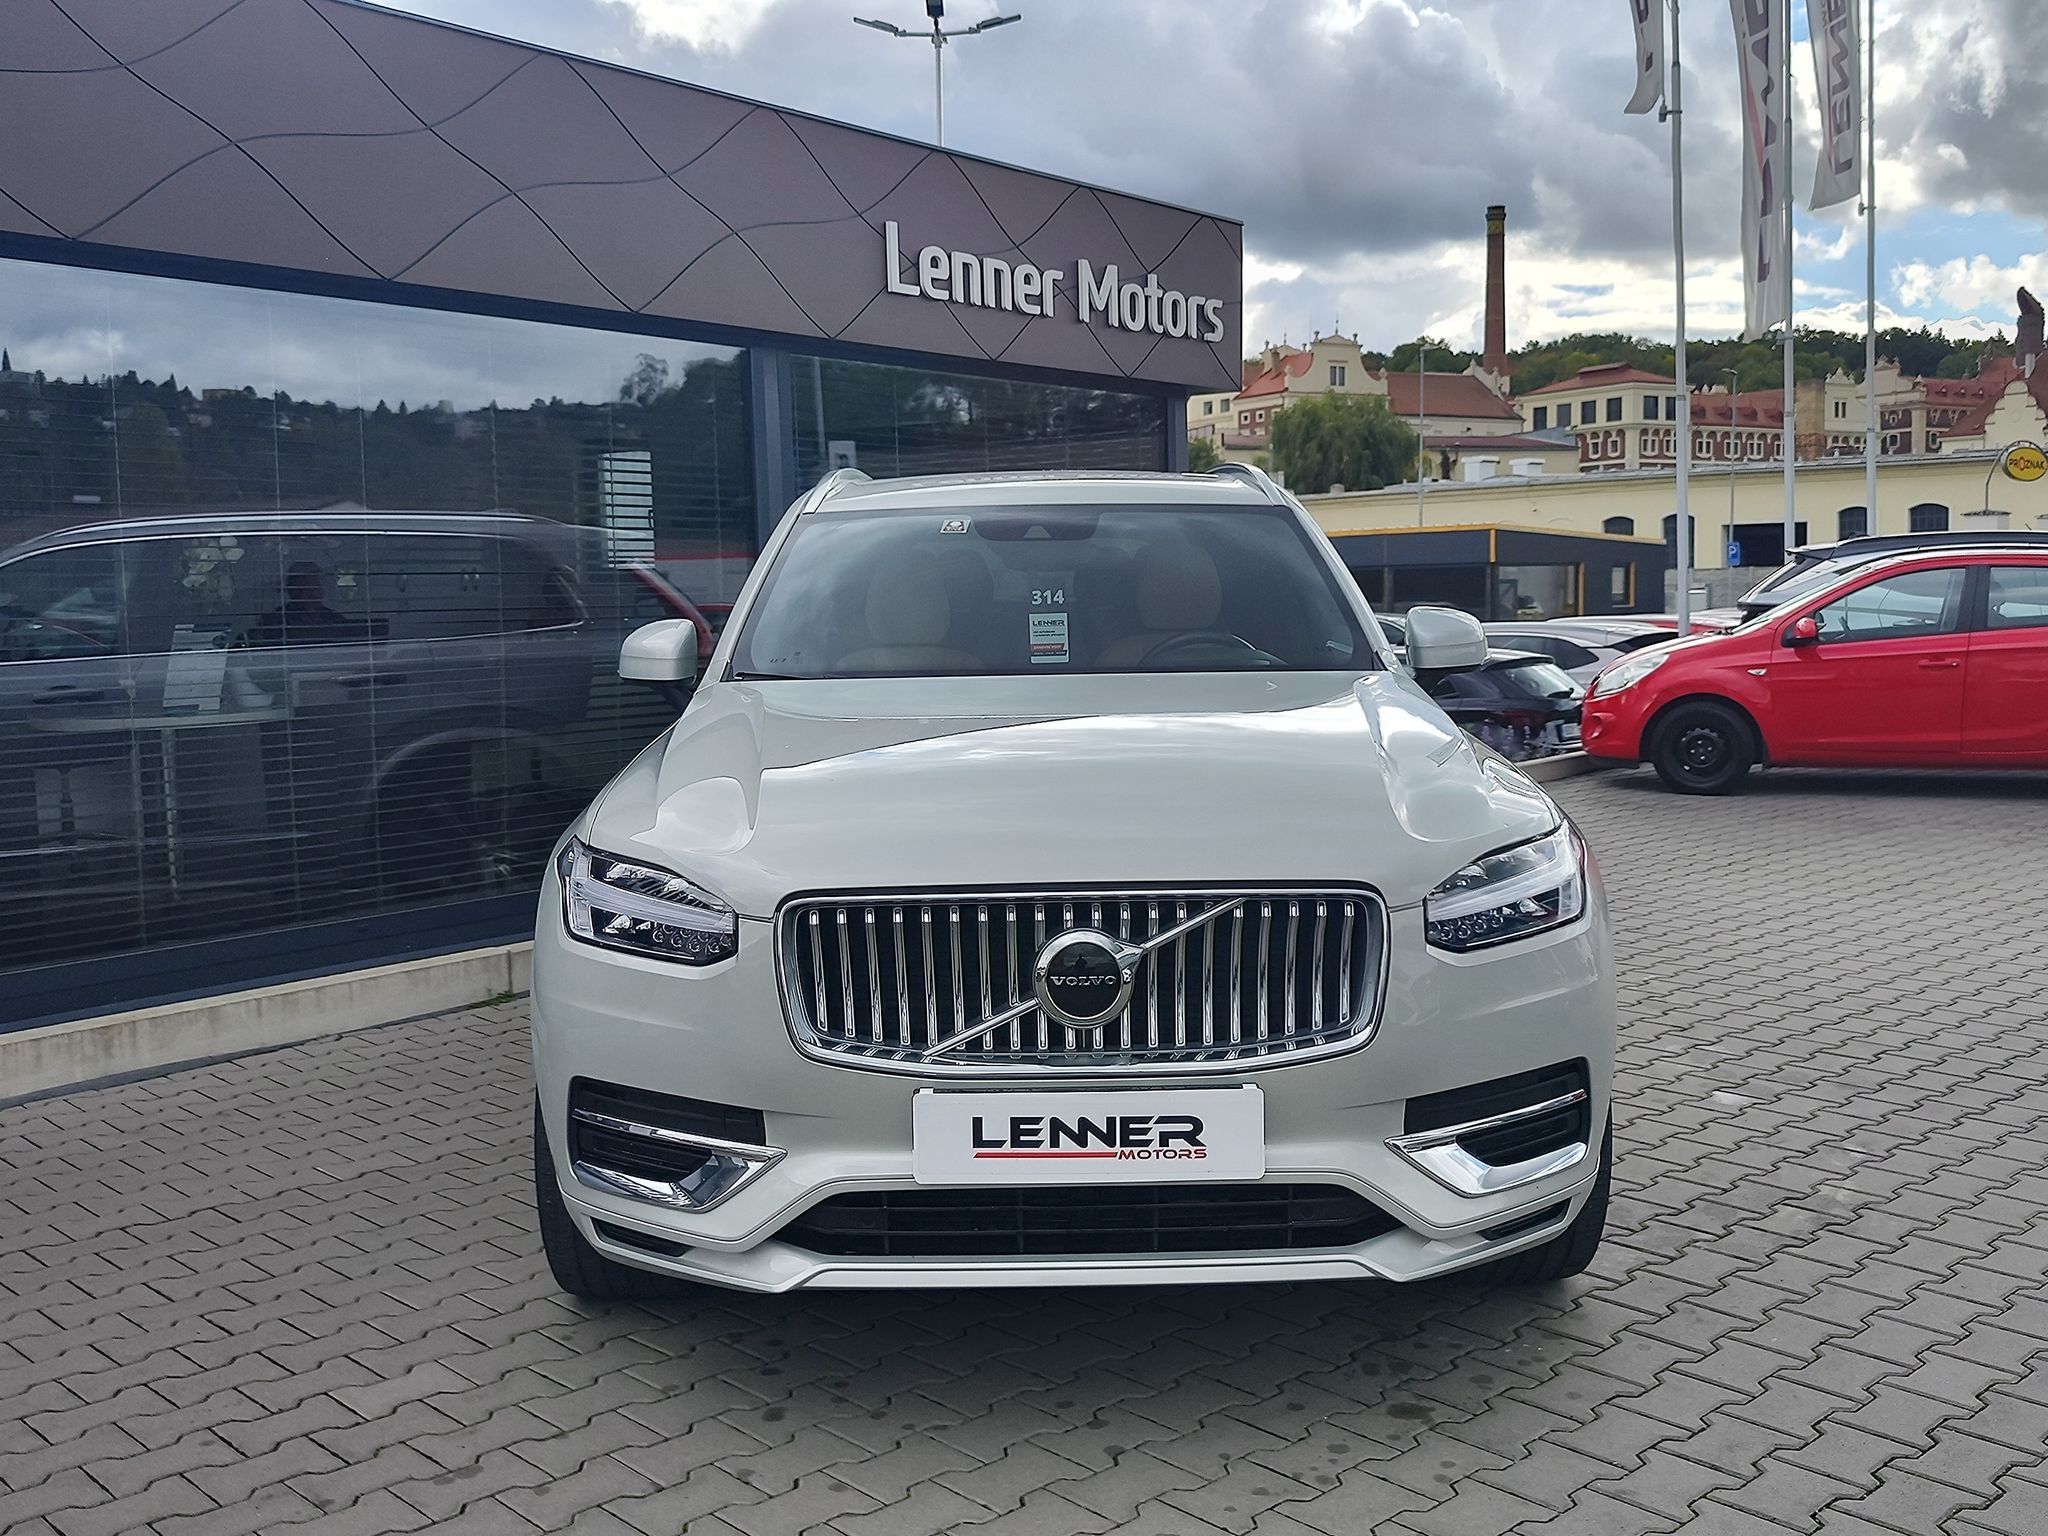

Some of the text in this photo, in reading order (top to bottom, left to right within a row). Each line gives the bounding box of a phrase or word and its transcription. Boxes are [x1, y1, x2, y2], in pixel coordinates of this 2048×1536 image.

[885, 220, 1224, 342] Lenner Motors
[1031, 589, 1065, 605] 314
[1032, 619, 1065, 627] LENNER
[1050, 975, 1117, 986] VOLVO
[972, 1115, 1207, 1149] LENNER
[1118, 1147, 1208, 1161] MOTORS
